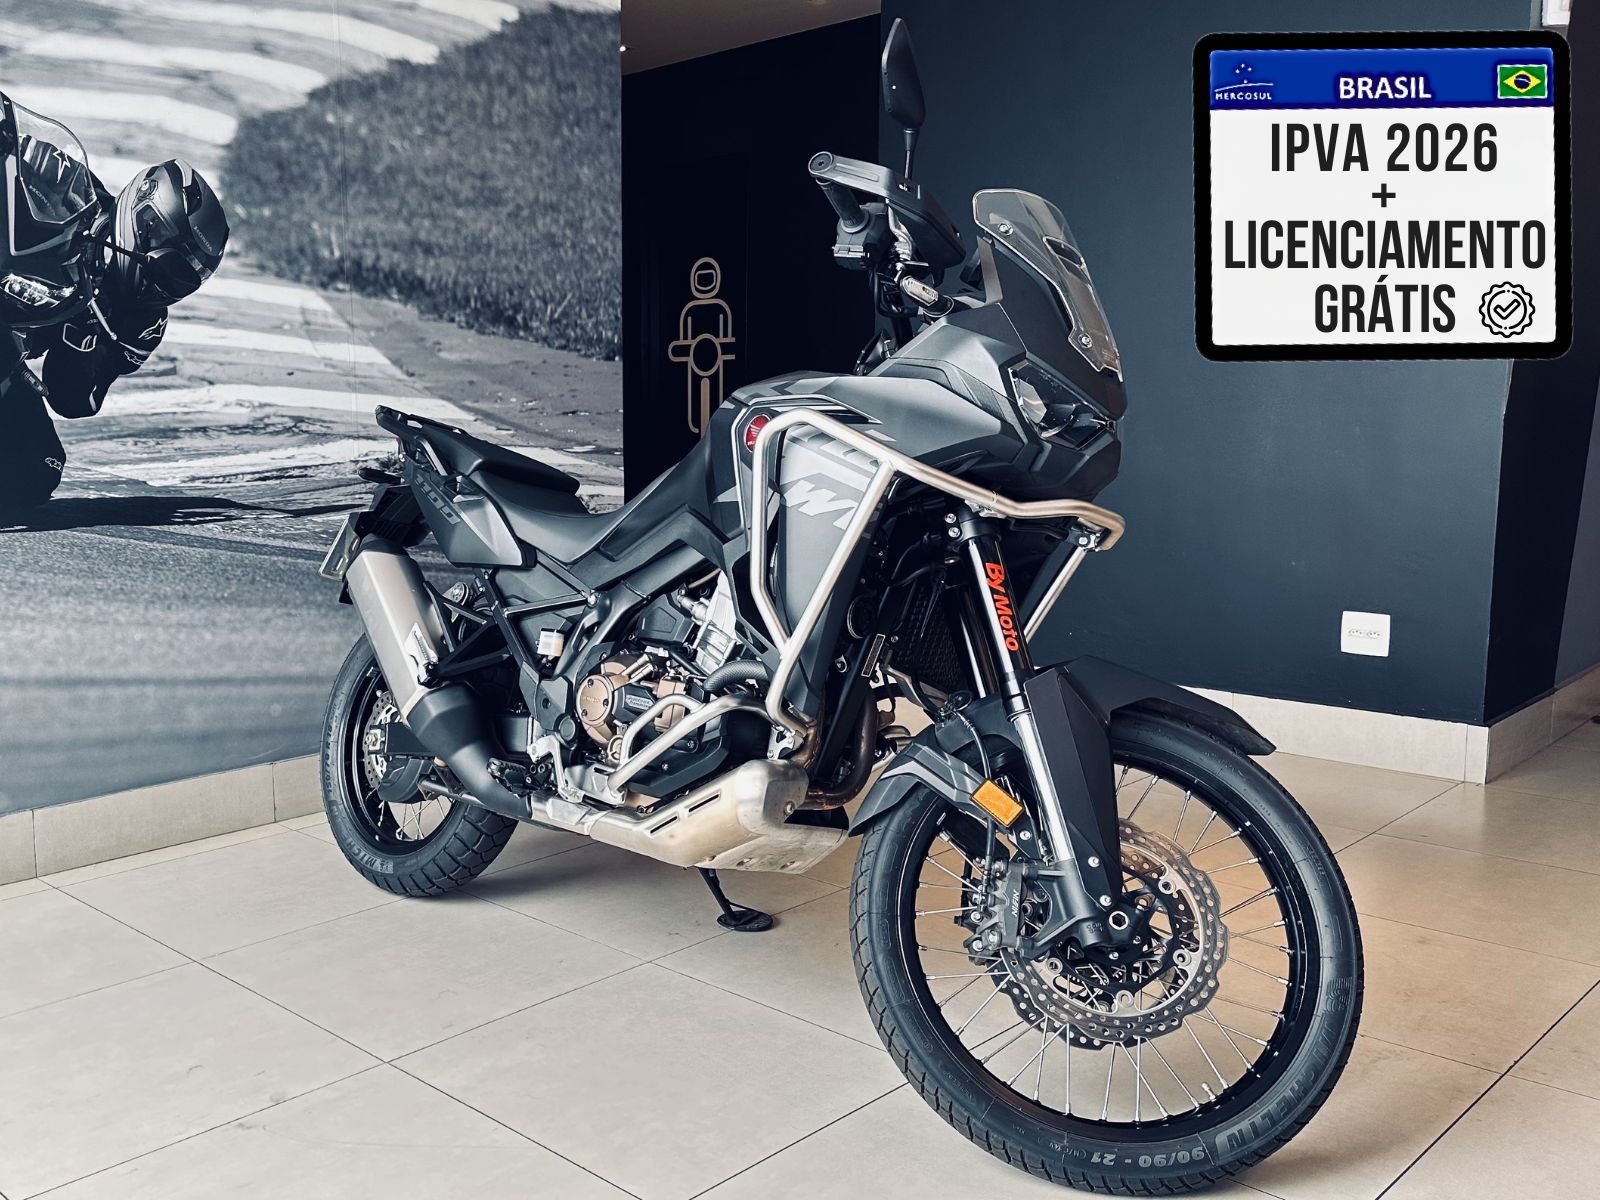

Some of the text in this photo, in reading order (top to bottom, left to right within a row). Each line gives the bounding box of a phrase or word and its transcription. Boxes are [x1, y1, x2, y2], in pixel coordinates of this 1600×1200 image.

[193, 225, 213, 252] HONDA
[1090, 1152, 1117, 1166] 21
[1138, 1146, 1205, 1168] 90/90
